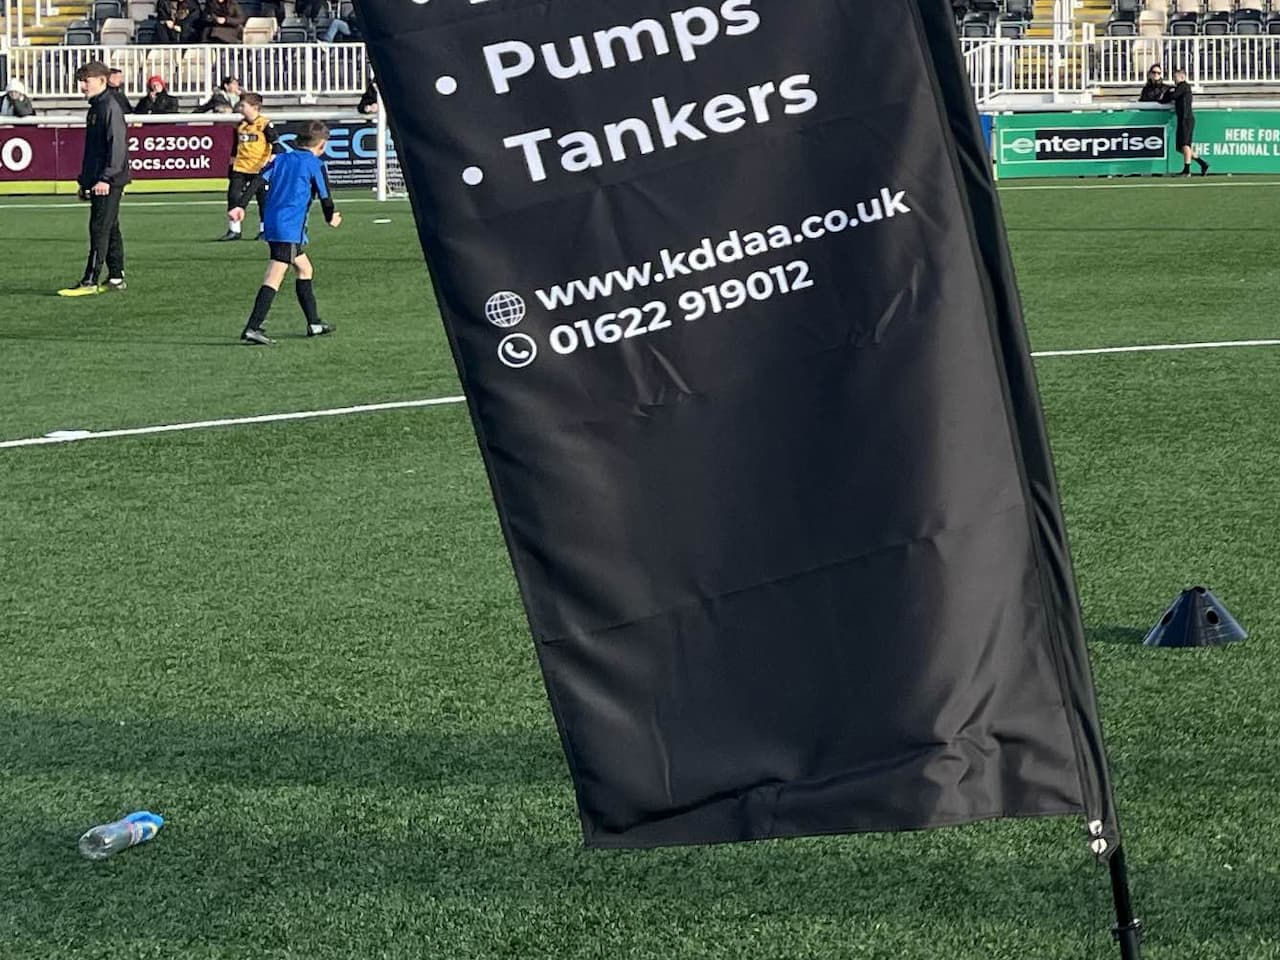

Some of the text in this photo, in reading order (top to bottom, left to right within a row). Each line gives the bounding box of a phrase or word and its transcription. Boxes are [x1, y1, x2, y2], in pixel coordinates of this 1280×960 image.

[503, 73, 818, 182] Tankers
[1225, 128, 1280, 141] HERE FOR
[143, 136, 213, 151] 623000
[1011, 132, 1164, 156] enterprise
[1213, 143, 1270, 156] NATIONAL
[128, 155, 210, 170] ocs.co.uk
[535, 187, 911, 310] www.kddaa.co.uk
[549, 260, 815, 354] 01622 919012
